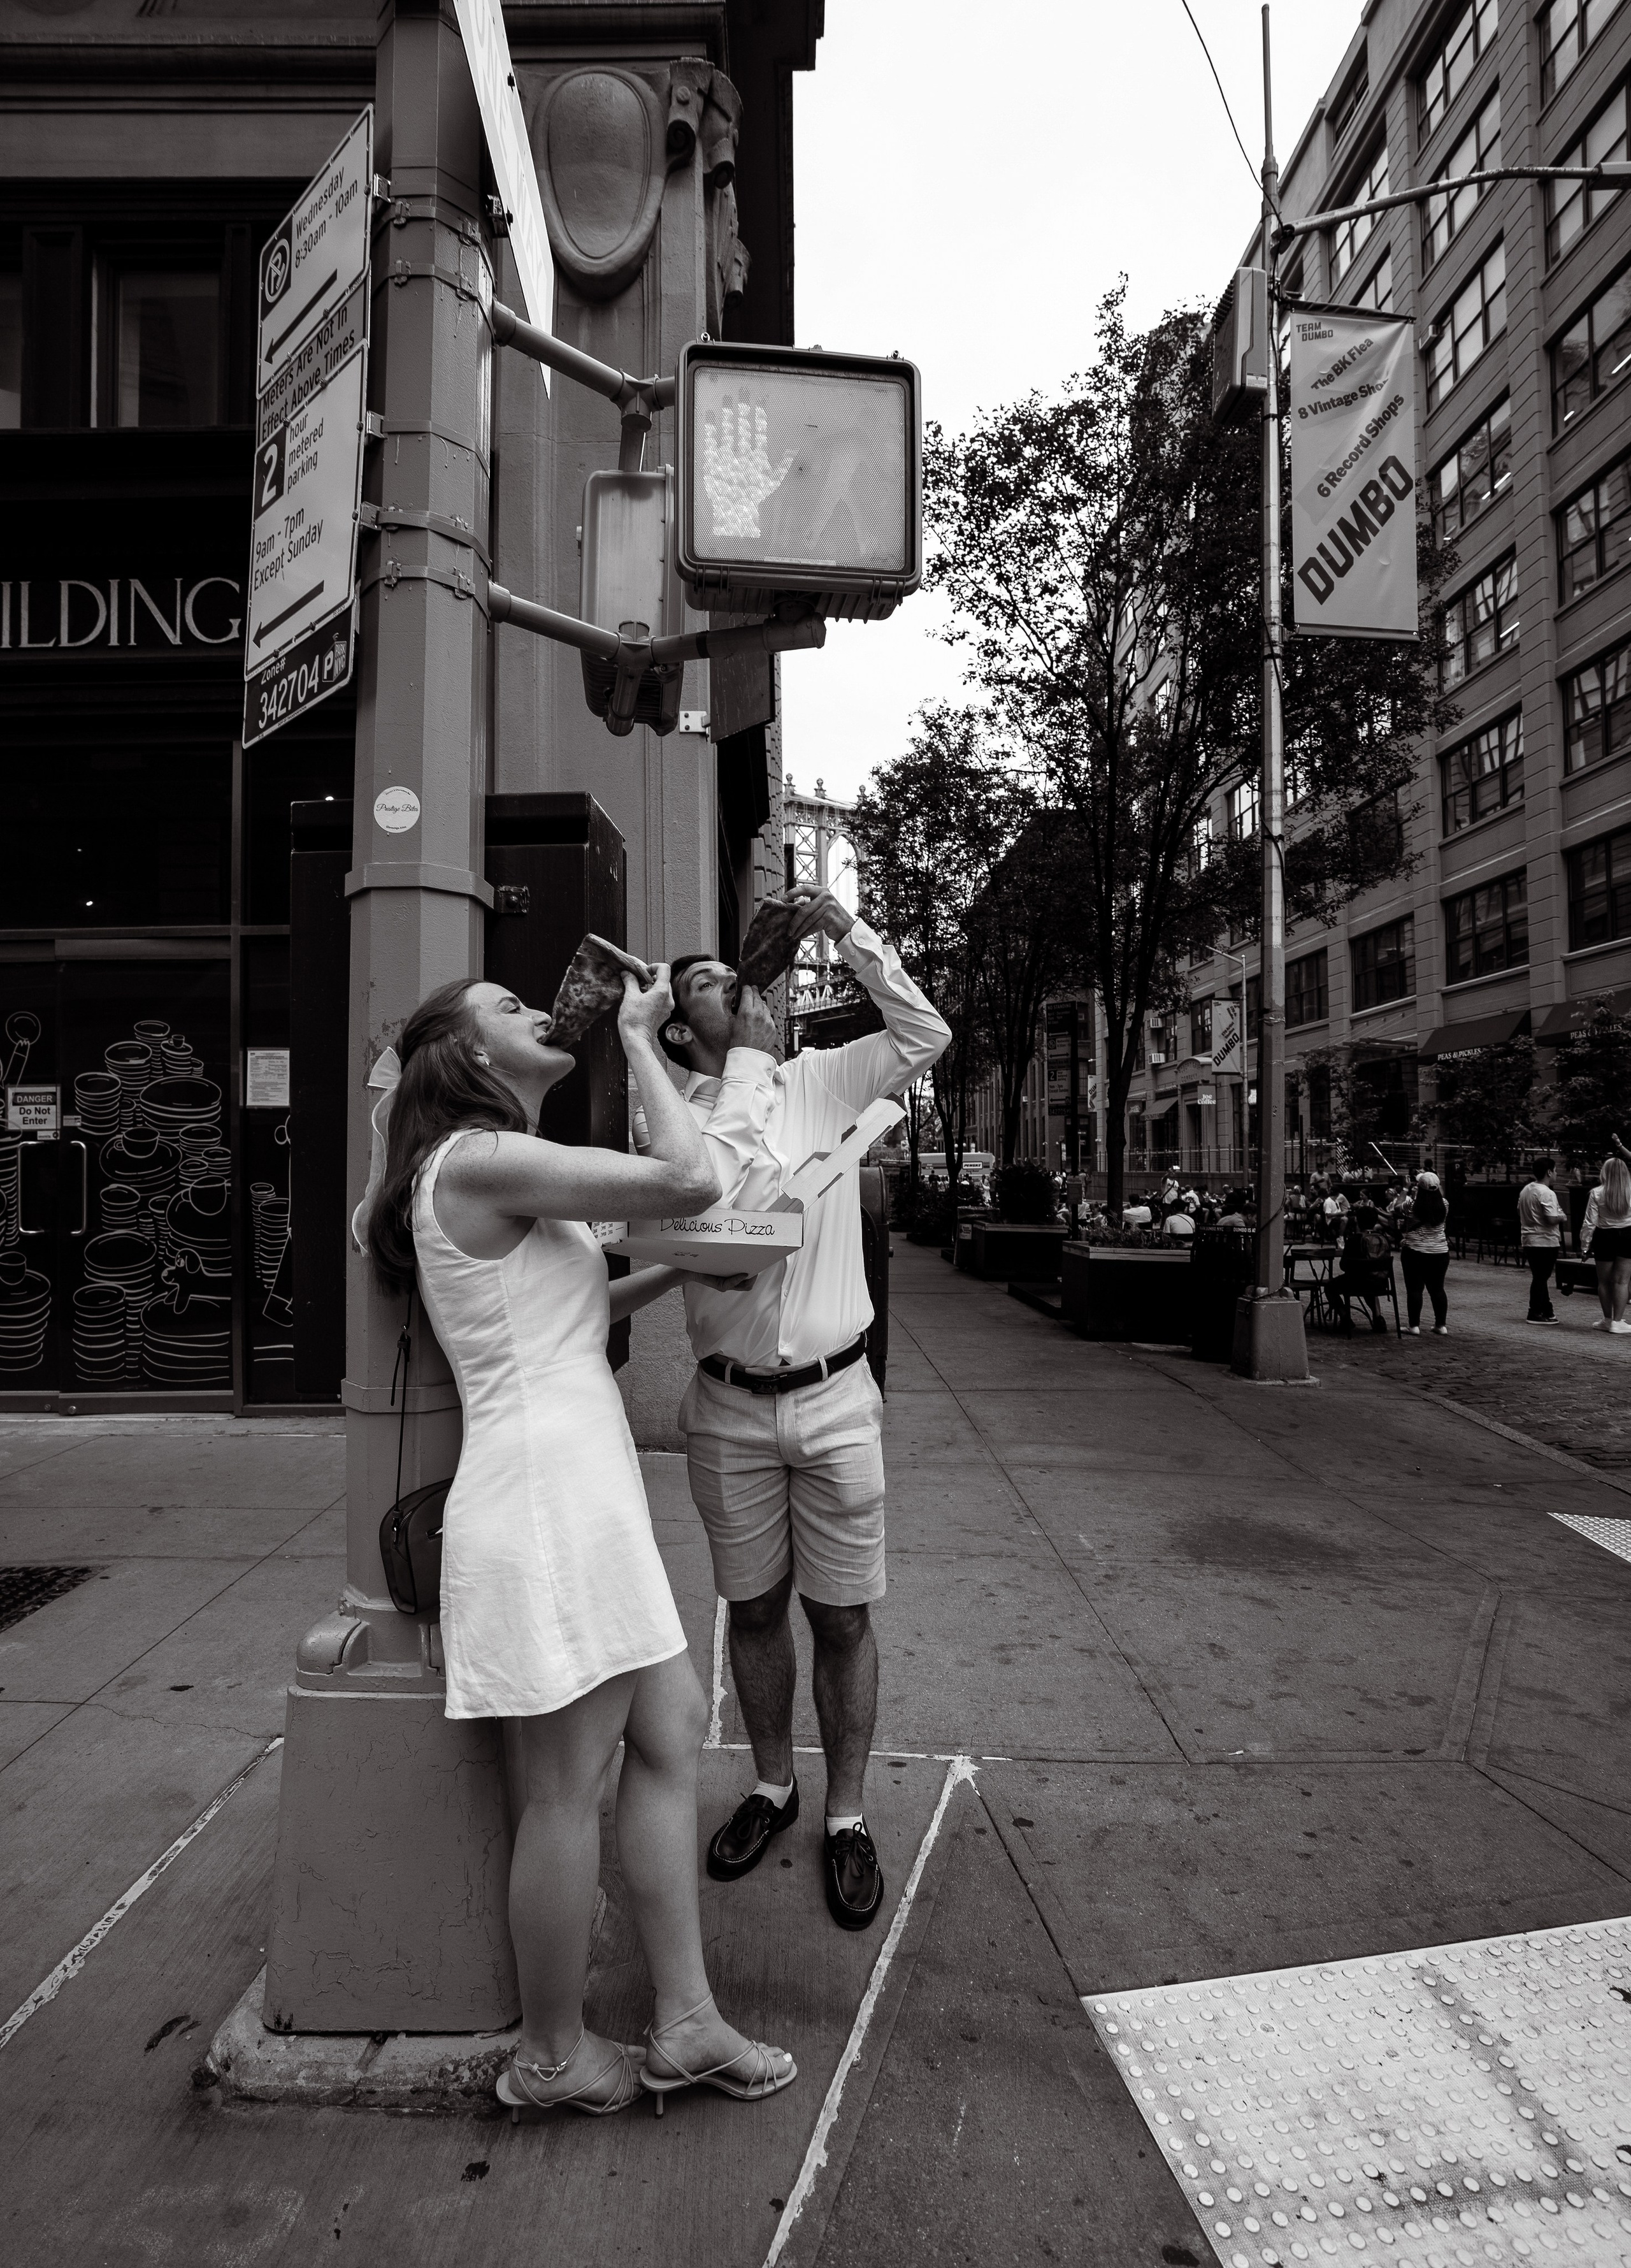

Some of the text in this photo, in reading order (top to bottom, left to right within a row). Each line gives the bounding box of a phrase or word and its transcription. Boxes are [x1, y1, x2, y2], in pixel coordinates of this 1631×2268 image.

[296, 166, 344, 240] Wednesday
[296, 220, 326, 268] 8:30am
[335, 179, 357, 219] 10am
[1296, 322, 1321, 333] TEAM
[1302, 329, 1333, 342] DUMBO
[263, 369, 294, 414] Meters
[296, 345, 313, 377] Are
[317, 319, 334, 354] Not
[338, 306, 347, 330] In
[1311, 338, 1374, 389] The BK Flea
[262, 398, 289, 442] Effect
[291, 367, 320, 412] Above
[324, 329, 355, 375] Times
[1298, 407, 1309, 419] 8
[1307, 391, 1358, 415] Vintage
[289, 417, 324, 466] metered
[290, 413, 308, 443] hour
[1317, 394, 1404, 498] 6 Record Shops
[261, 444, 278, 507] 2
[287, 451, 318, 495] parking
[256, 534, 275, 563] 9am
[284, 508, 304, 539] 7pm
[1297, 455, 1413, 605] DUMBO
[254, 519, 324, 591] Except Sunday
[1, 577, 241, 648] ILDING
[259, 654, 319, 729] 342704
[261, 656, 286, 685] Zone#
[1212, 1032, 1240, 1067] DUMBO
[1437, 1052, 1452, 1060] PEAS
[1459, 1048, 1481, 1057] PICKLES
[1570, 1030, 1586, 1039] PEAS
[1050, 1071, 1054, 1080] 2
[19, 1107, 50, 1115] Do Not
[661, 1217, 775, 1235] Delicious Pizza
